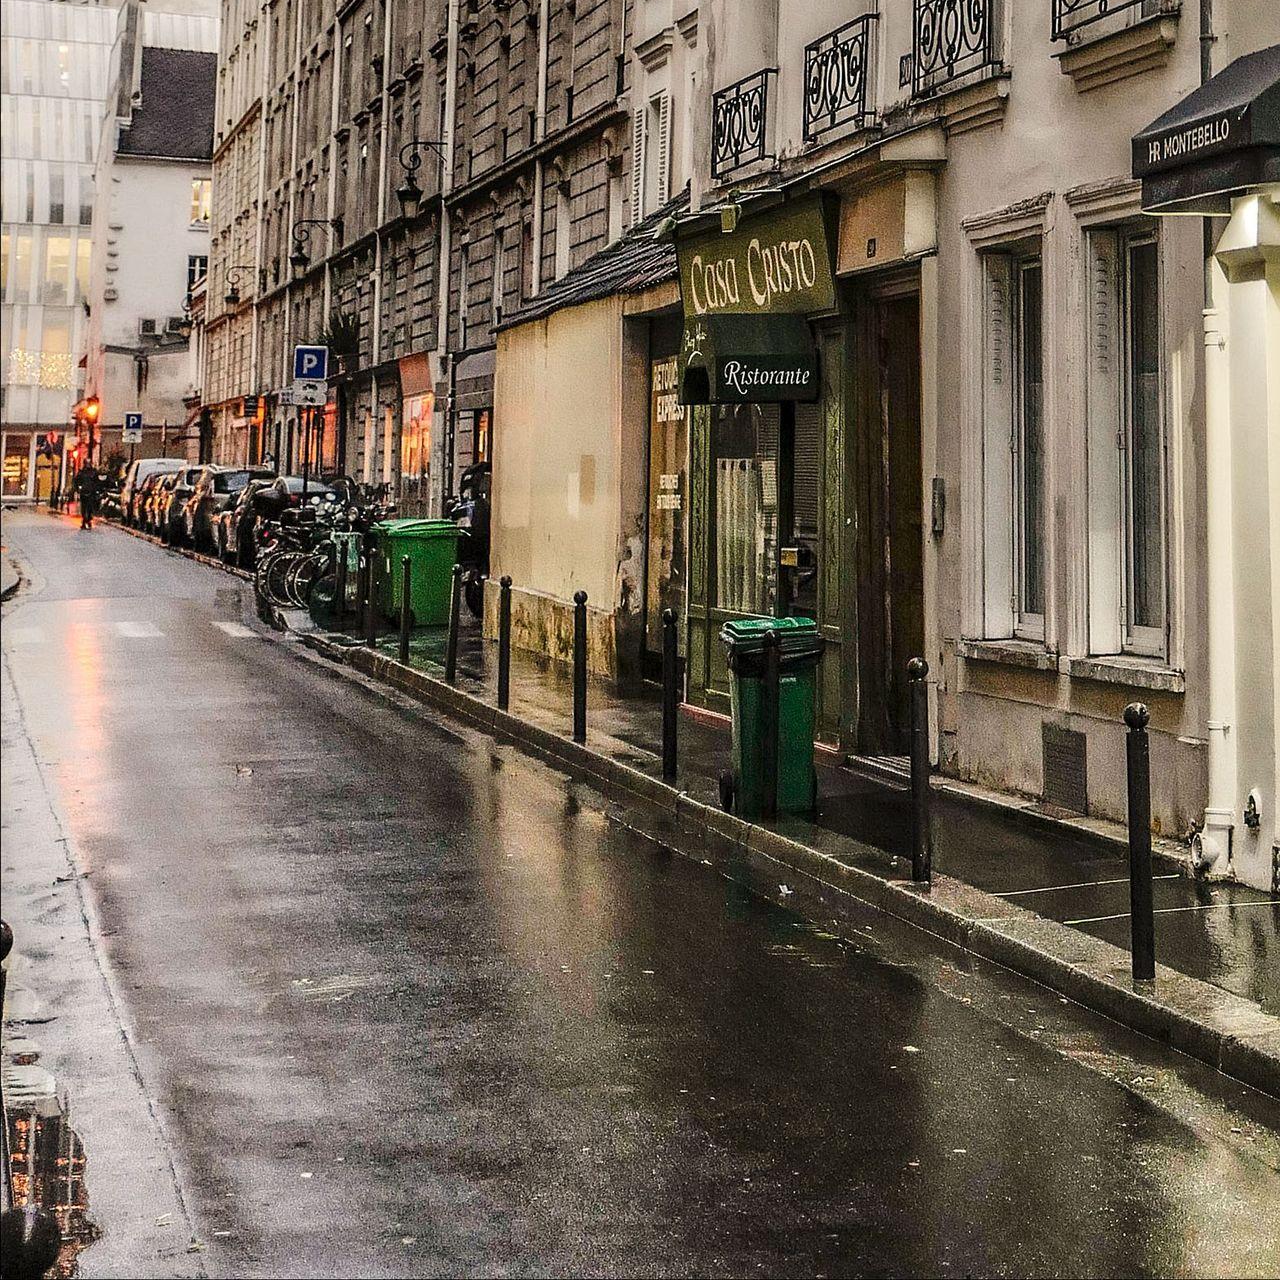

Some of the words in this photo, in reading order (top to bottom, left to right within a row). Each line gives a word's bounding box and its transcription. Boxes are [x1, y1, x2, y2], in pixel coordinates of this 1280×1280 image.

[1148, 141, 1161, 164] HR
[1163, 118, 1230, 160] MONTEBELLO
[690, 255, 741, 314] Casa
[302, 353, 319, 375] P
[724, 360, 811, 395] Ristorante
